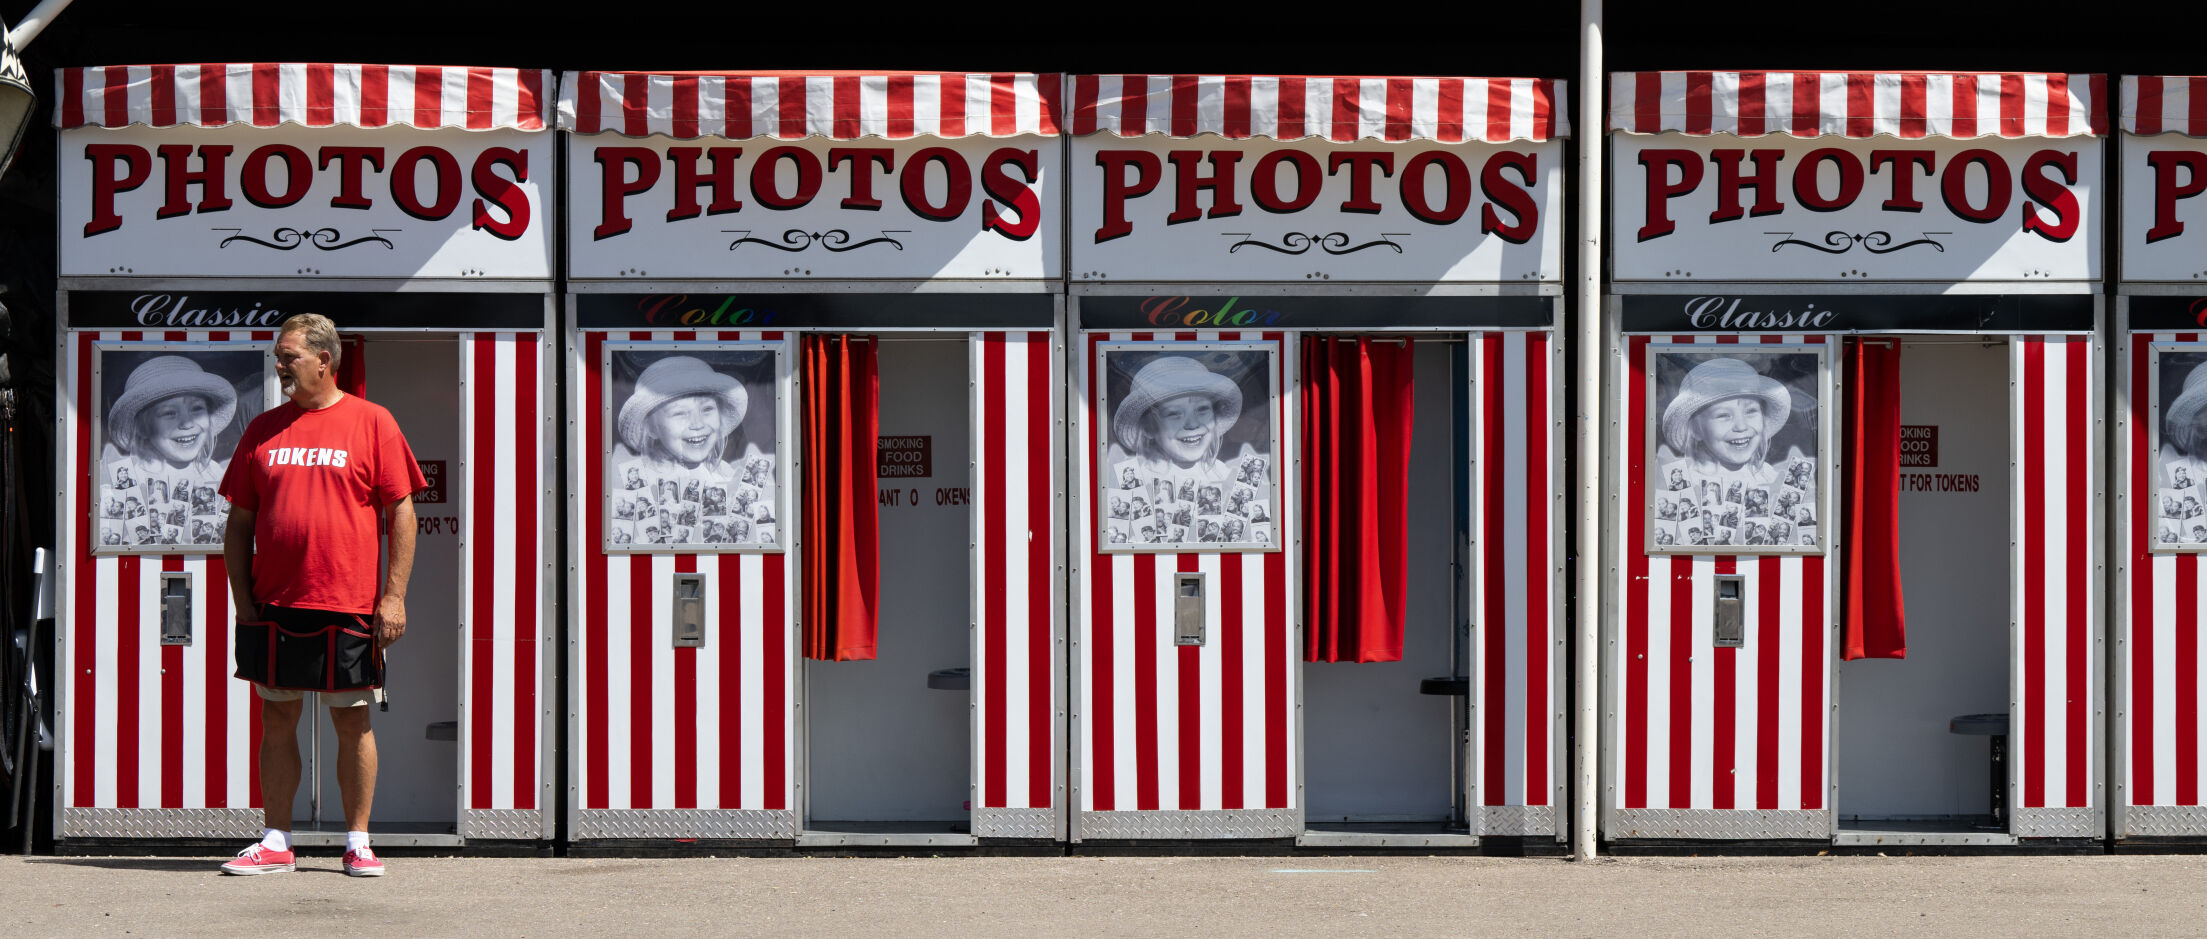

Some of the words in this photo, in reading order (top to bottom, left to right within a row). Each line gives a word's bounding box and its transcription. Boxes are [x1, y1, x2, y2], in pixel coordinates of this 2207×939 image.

[84, 143, 531, 241] PHOTOS
[594, 145, 1041, 242] PHOTOS
[1095, 149, 1539, 244] PHOTOS
[1637, 148, 2080, 243] PHOTOS
[131, 294, 286, 326] Classic
[638, 294, 778, 326] Color
[1140, 296, 1292, 326] Color
[1684, 296, 1839, 328] Classic
[878, 438, 924, 449] SMOKING
[1900, 427, 1931, 439] OKING
[1901, 440, 1929, 451] OOD
[268, 447, 348, 468] TOKENS
[885, 451, 922, 462] FOOD
[880, 465, 924, 476] DRINKS
[1910, 473, 1932, 492] FOR
[1935, 473, 1980, 493] TOKENS
[879, 488, 900, 507] ANT
[417, 516, 441, 535] FOR
